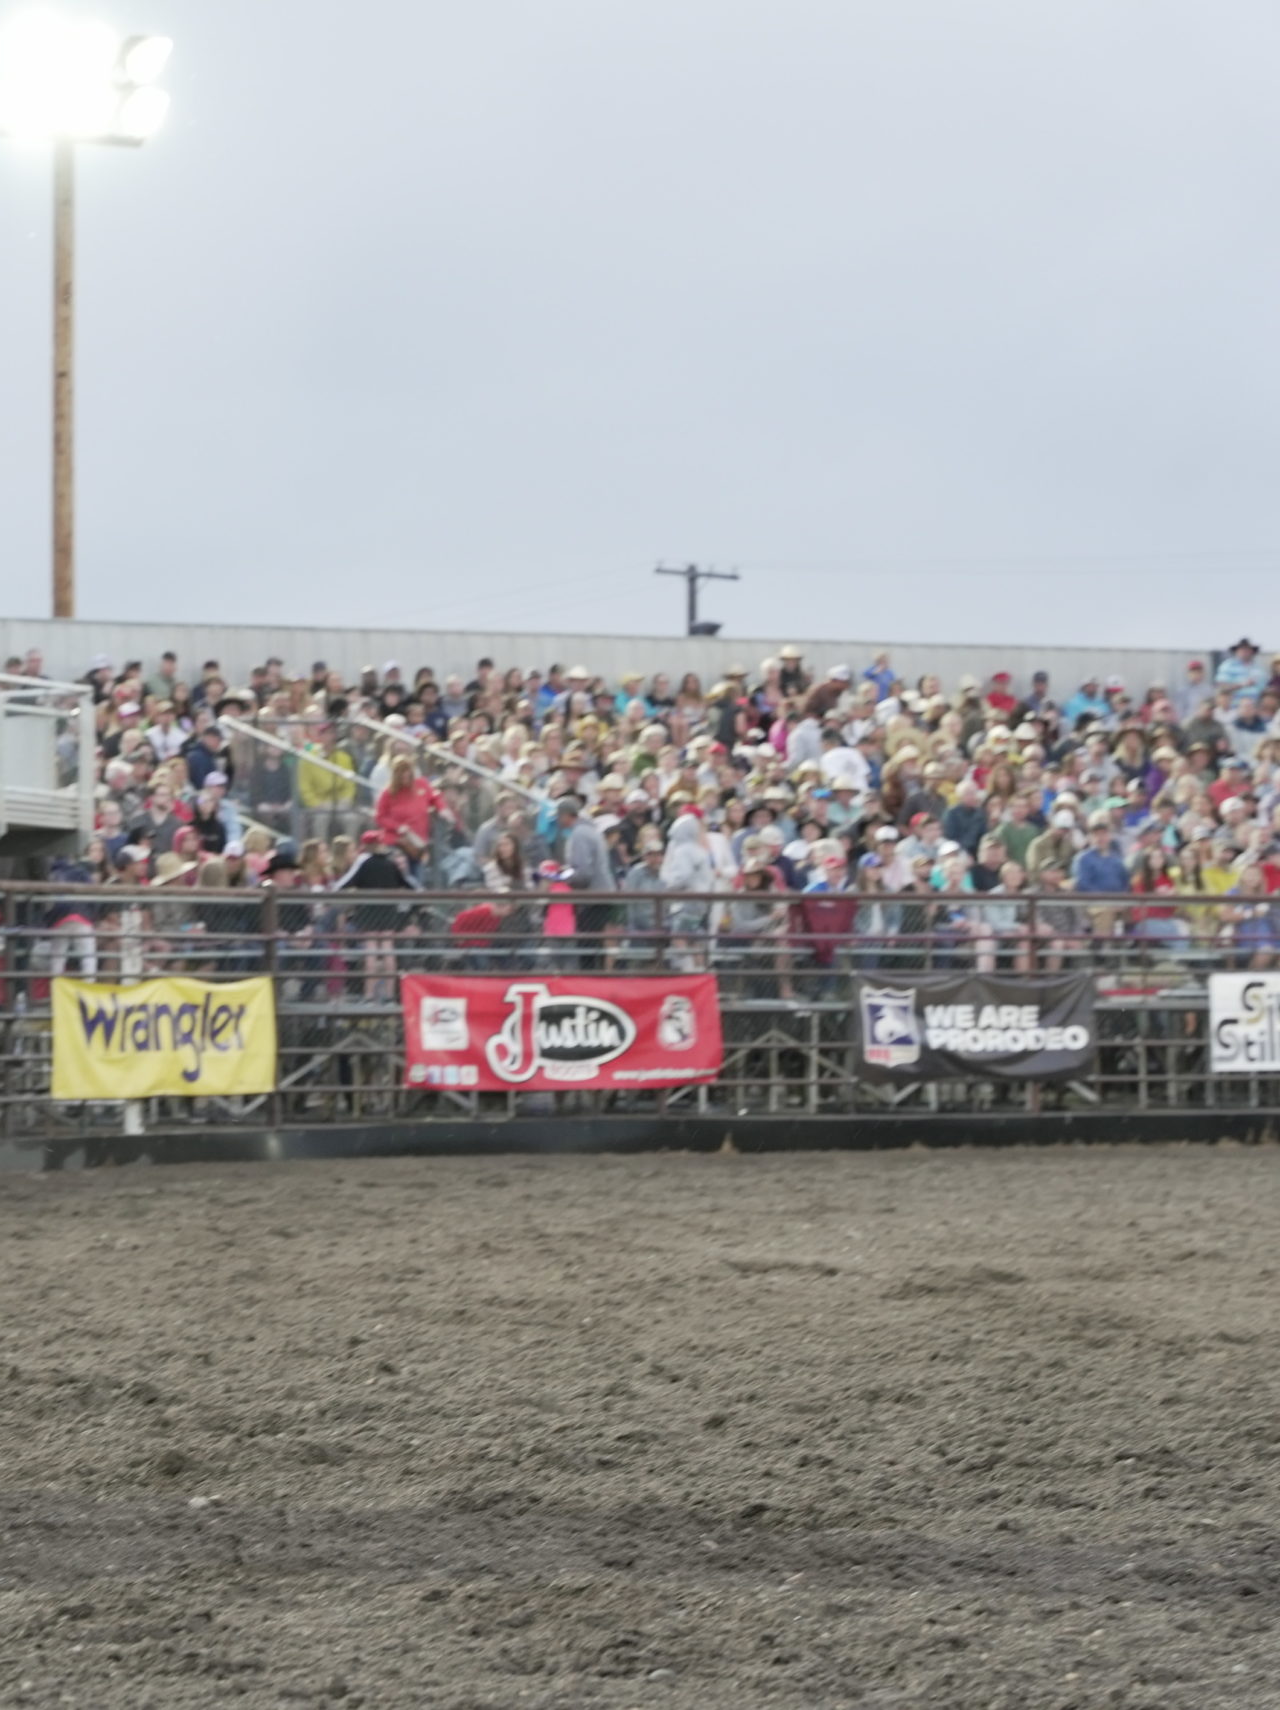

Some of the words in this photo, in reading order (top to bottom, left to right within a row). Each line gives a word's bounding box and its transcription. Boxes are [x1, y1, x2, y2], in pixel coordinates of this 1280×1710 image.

[77, 991, 247, 1083] Wrangler
[485, 983, 622, 1083] Justin
[924, 1004, 975, 1029] WE
[978, 1004, 1040, 1029] ARE
[925, 1024, 1090, 1054] PRORODEO
